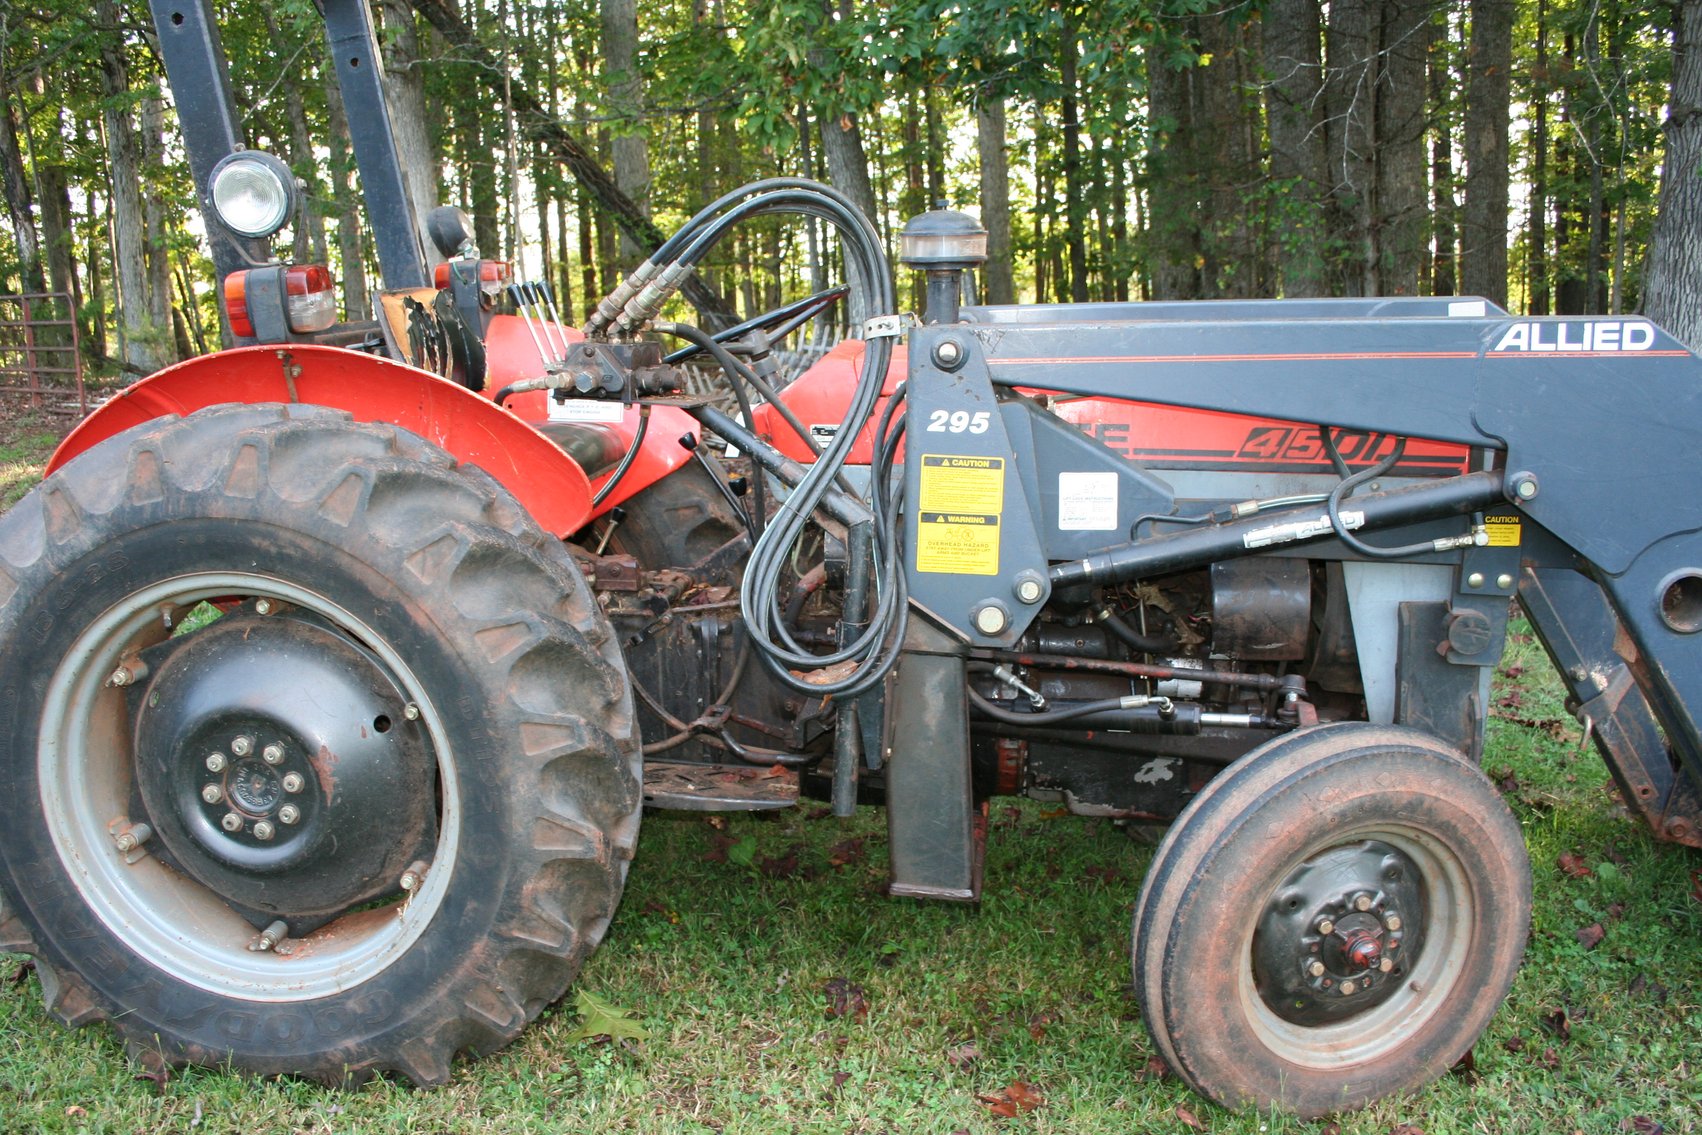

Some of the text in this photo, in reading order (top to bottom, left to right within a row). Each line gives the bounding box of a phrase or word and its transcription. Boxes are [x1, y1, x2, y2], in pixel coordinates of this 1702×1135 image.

[1494, 322, 1655, 350] ALLIED
[926, 409, 990, 434] 295
[951, 459, 990, 467] CAUTION
[947, 515, 985, 523] WARNING
